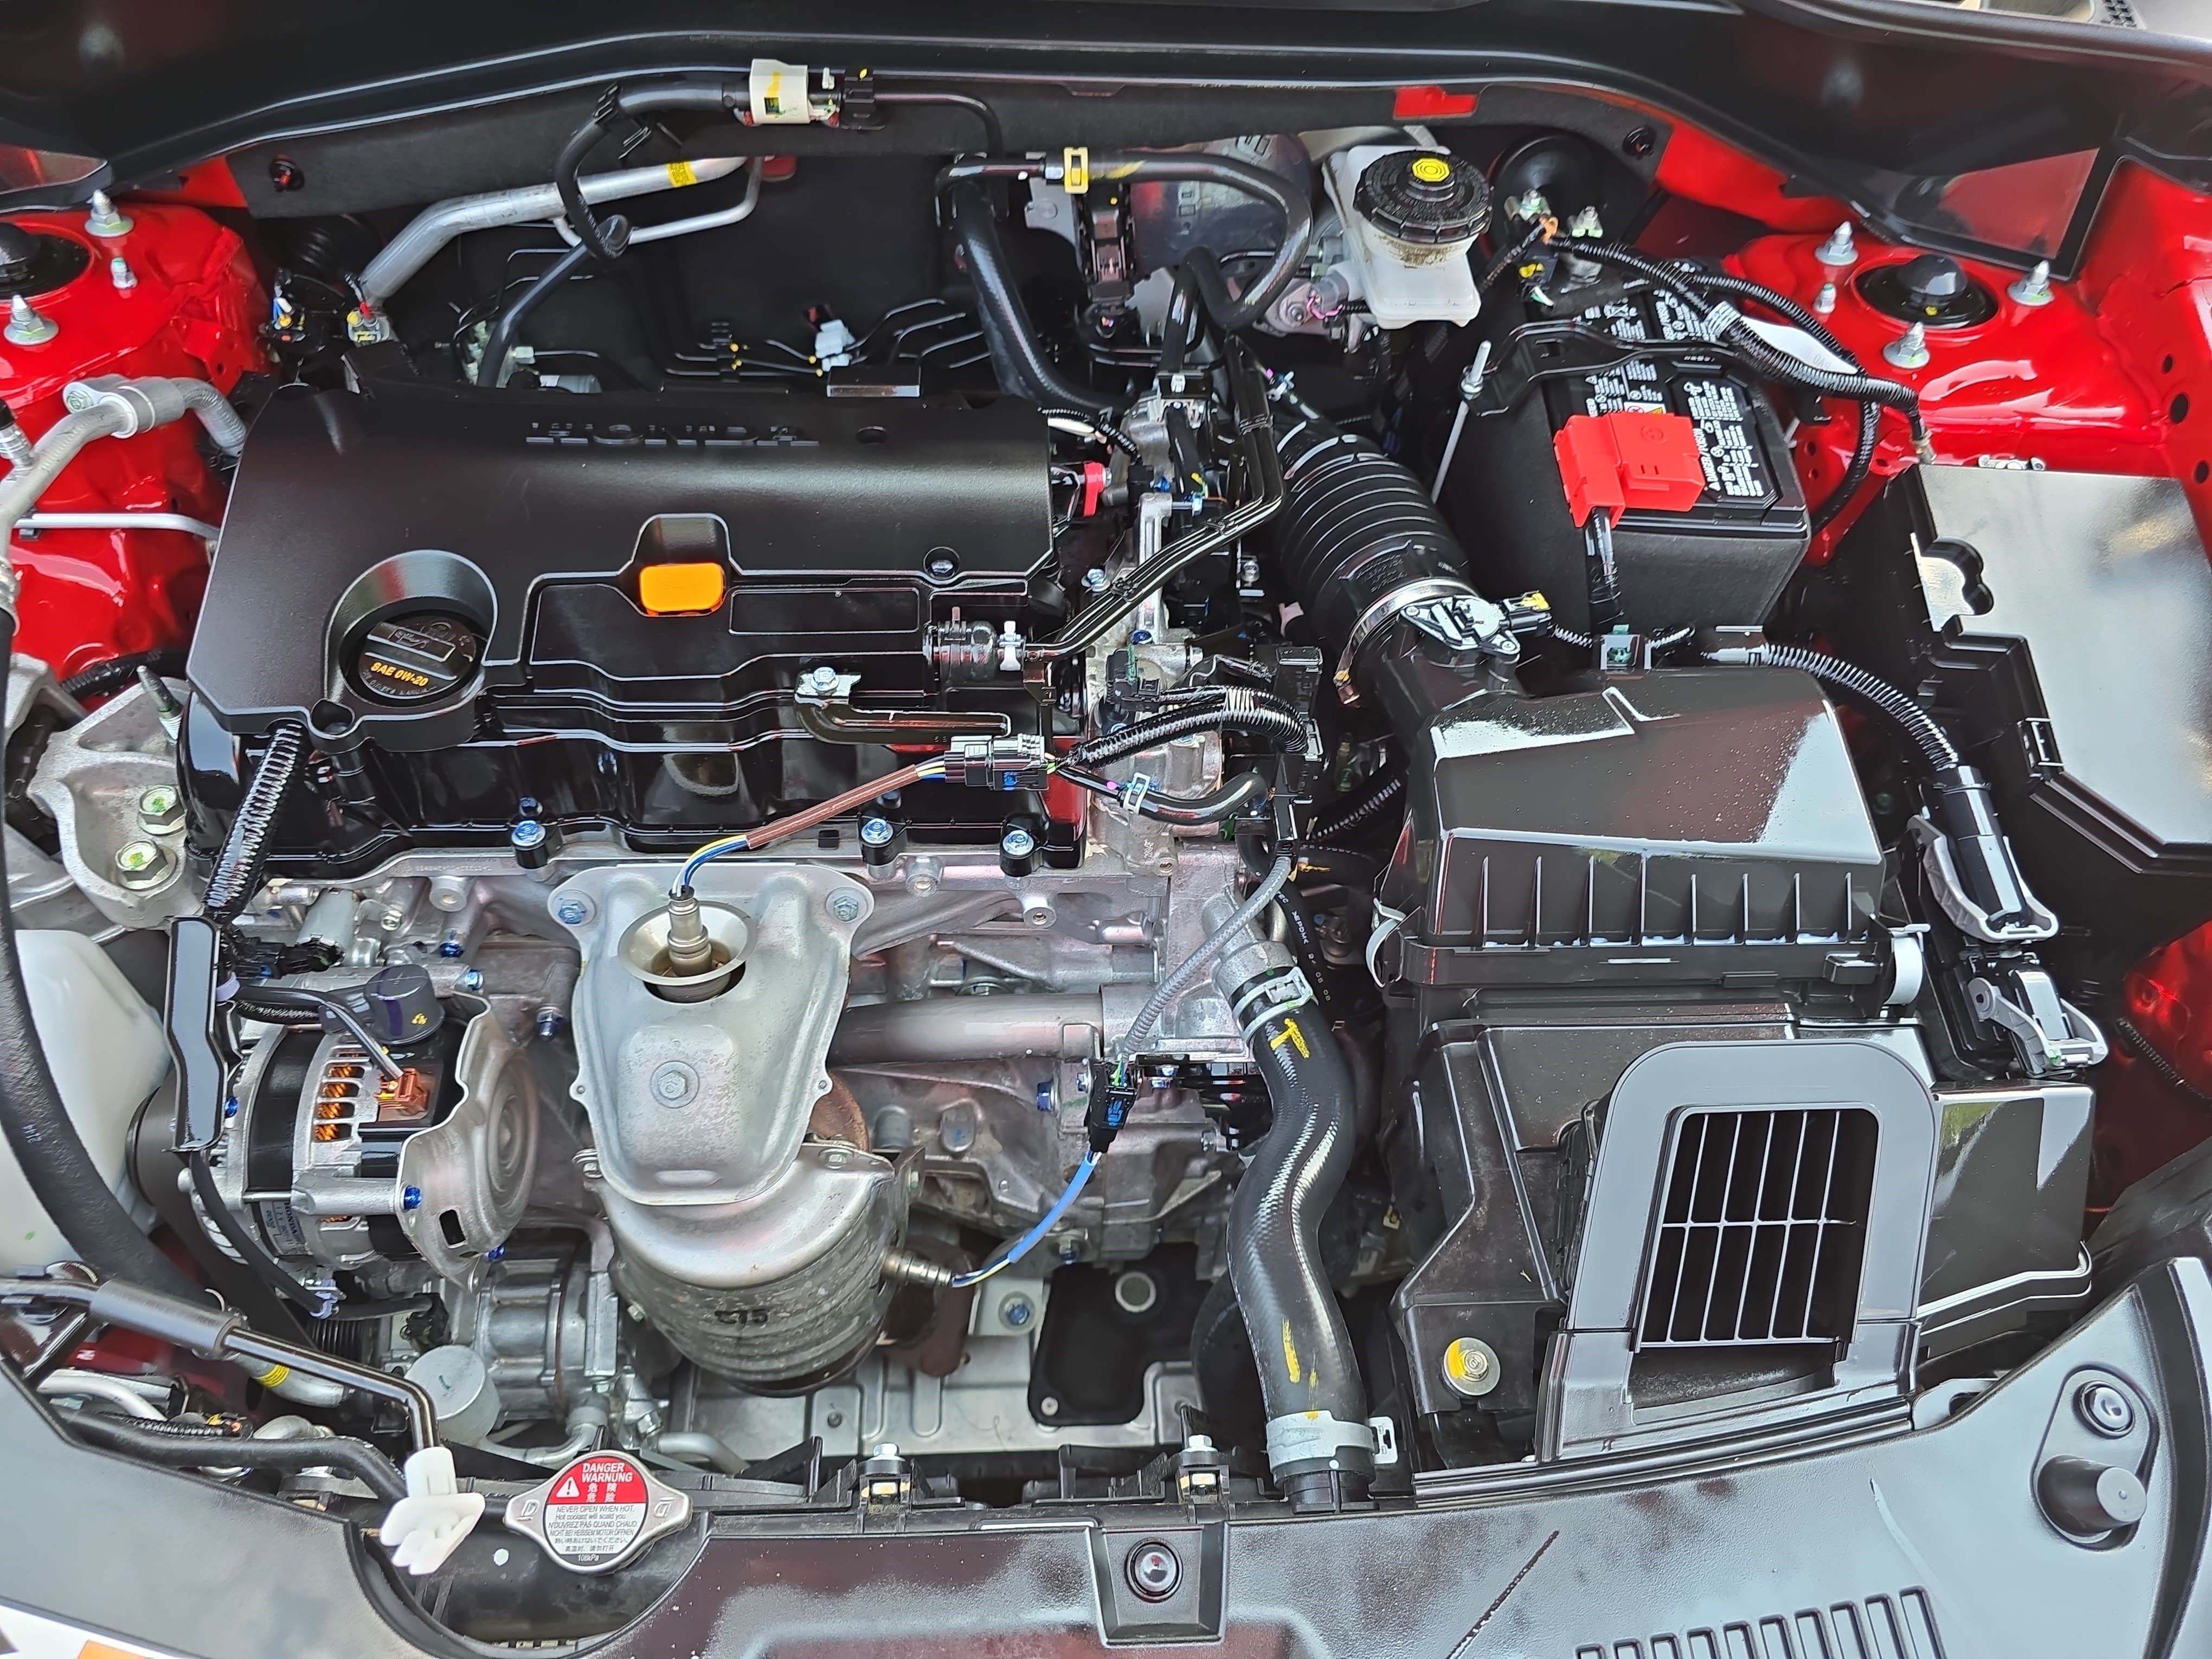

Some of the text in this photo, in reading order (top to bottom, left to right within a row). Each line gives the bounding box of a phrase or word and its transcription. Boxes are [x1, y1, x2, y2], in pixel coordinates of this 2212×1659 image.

[370, 662, 397, 676] SAE
[394, 670, 429, 686] 0W-20
[284, 1202, 297, 1234] HONDA
[582, 1463, 625, 1473] DANGER
[581, 1472, 633, 1483] WARNUNG
